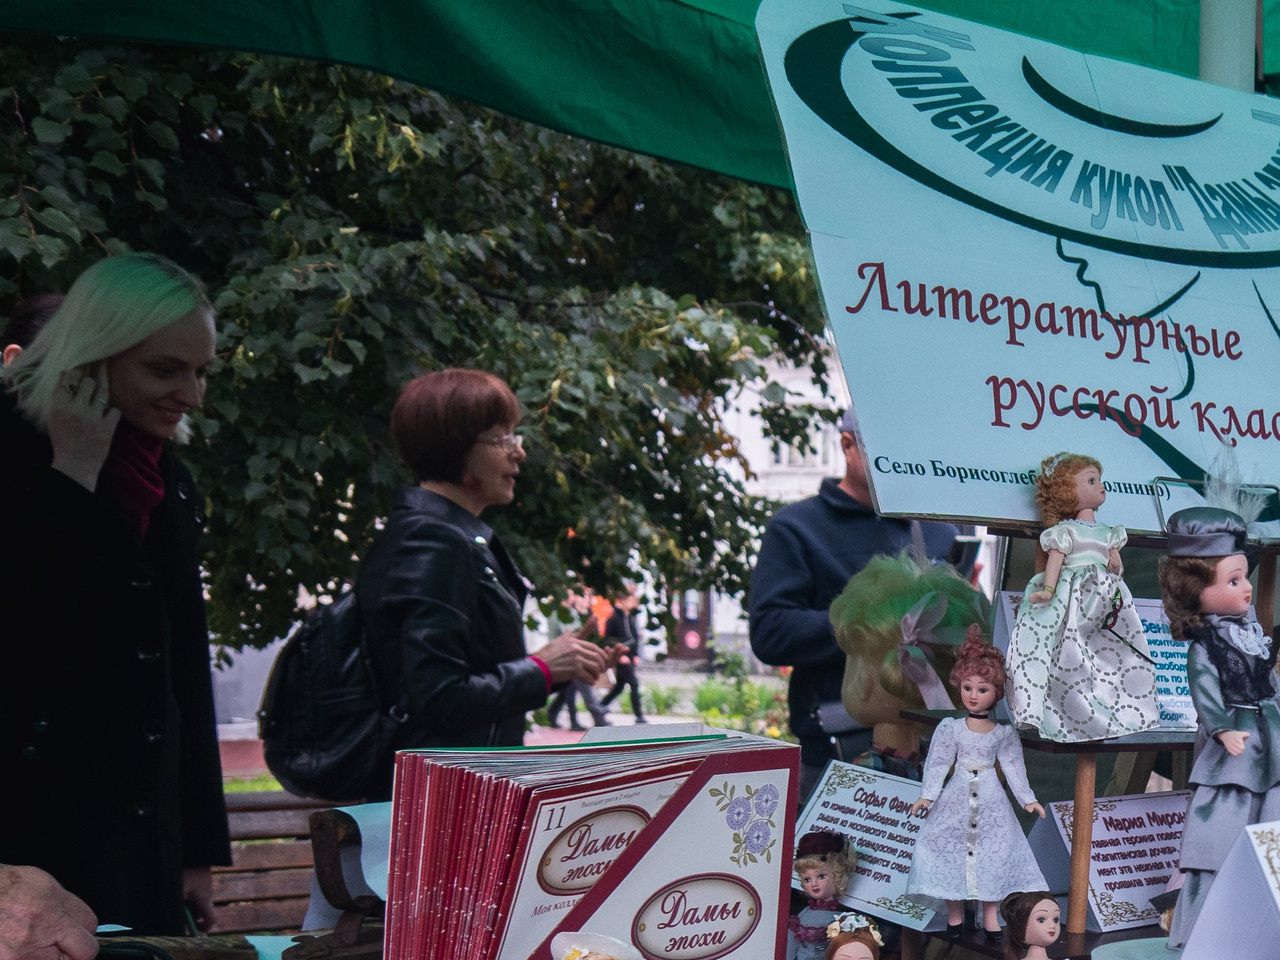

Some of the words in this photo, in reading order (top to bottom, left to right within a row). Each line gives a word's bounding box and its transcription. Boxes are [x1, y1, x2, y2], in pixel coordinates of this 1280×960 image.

[842, 3, 1073, 193] Коллекция
[1070, 160, 1184, 231] кукол
[846, 261, 1243, 364] Литературные
[987, 373, 1179, 437] русской
[874, 455, 925, 476] Село
[930, 460, 1036, 486] Борисоглеб
[1103, 480, 1170, 500] олнино)
[543, 806, 567, 832] 11
[853, 787, 888, 808] Софья
[889, 797, 931, 821] Фамусо
[1102, 814, 1146, 833] Мария
[1146, 811, 1186, 830] Мирон
[561, 822, 637, 863] Дамы
[1092, 837, 1121, 849] лавная
[1122, 833, 1156, 847] героиня
[531, 904, 552, 918] Моя
[553, 899, 579, 912] колле
[657, 890, 742, 930] Дамы
[665, 929, 726, 952] эпохи
